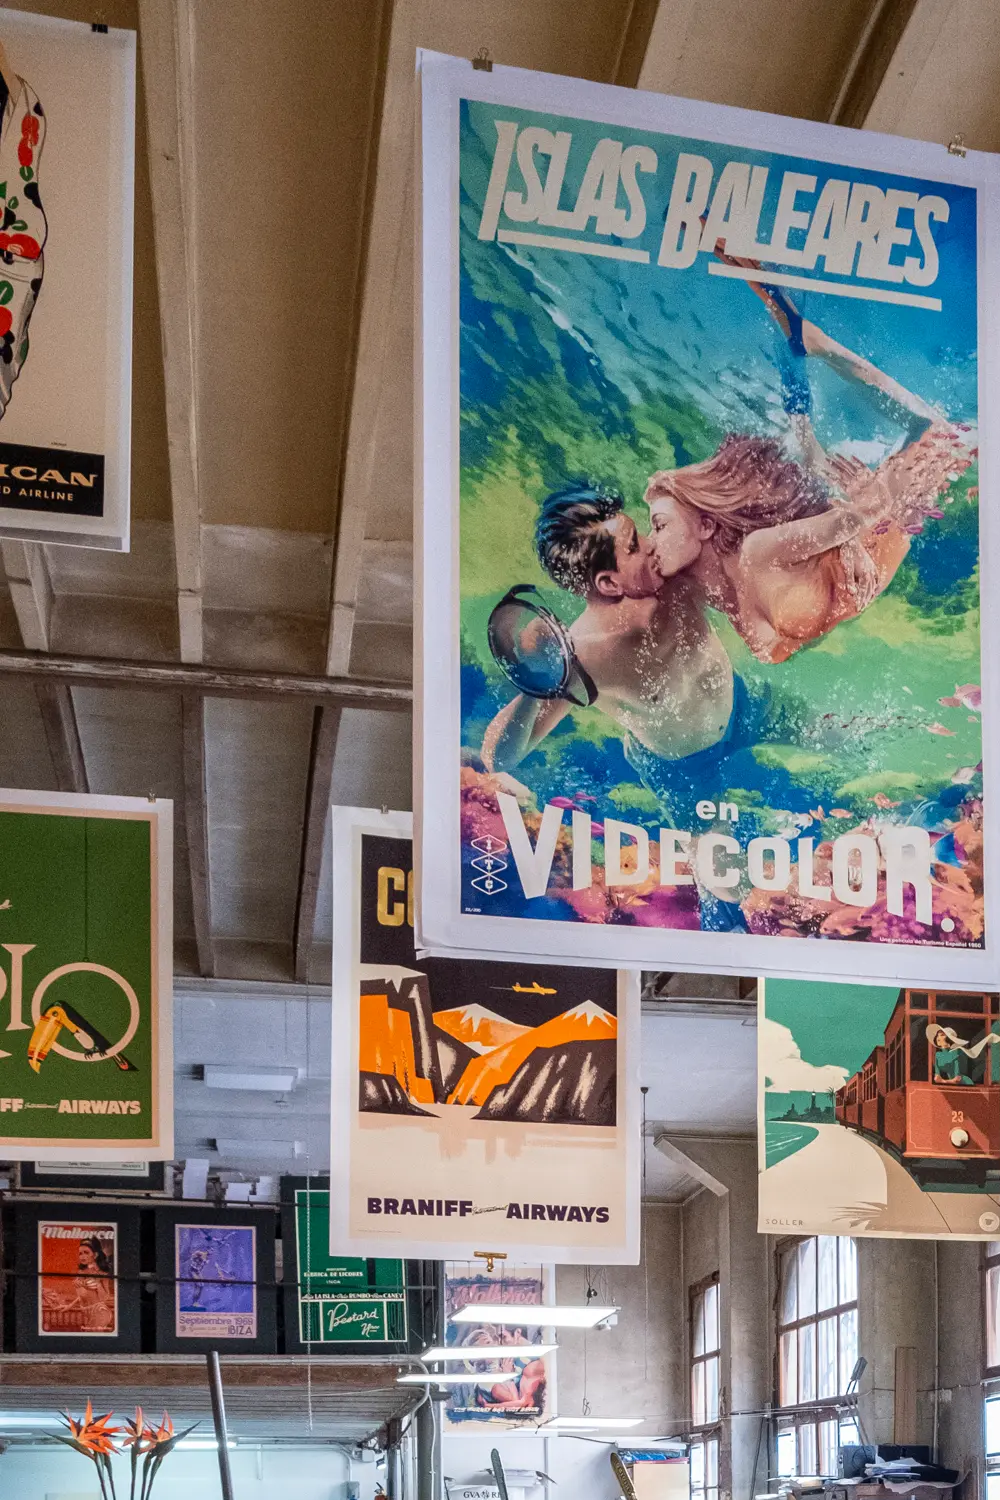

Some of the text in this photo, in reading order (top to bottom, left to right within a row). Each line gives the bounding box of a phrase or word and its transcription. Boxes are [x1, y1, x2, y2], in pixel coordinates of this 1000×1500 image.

[478, 119, 950, 288] ISLAS BALEARES
[19, 487, 74, 502] AIRLINE
[696, 799, 739, 822] en
[58, 1100, 141, 1115] AIRWAYS
[950, 1110, 965, 1124] 23
[367, 1197, 473, 1217] BRANIFF
[506, 1202, 610, 1223] AIRWAYS
[765, 1218, 804, 1226] SOLLER
[463, 1490, 480, 1499] GVA
